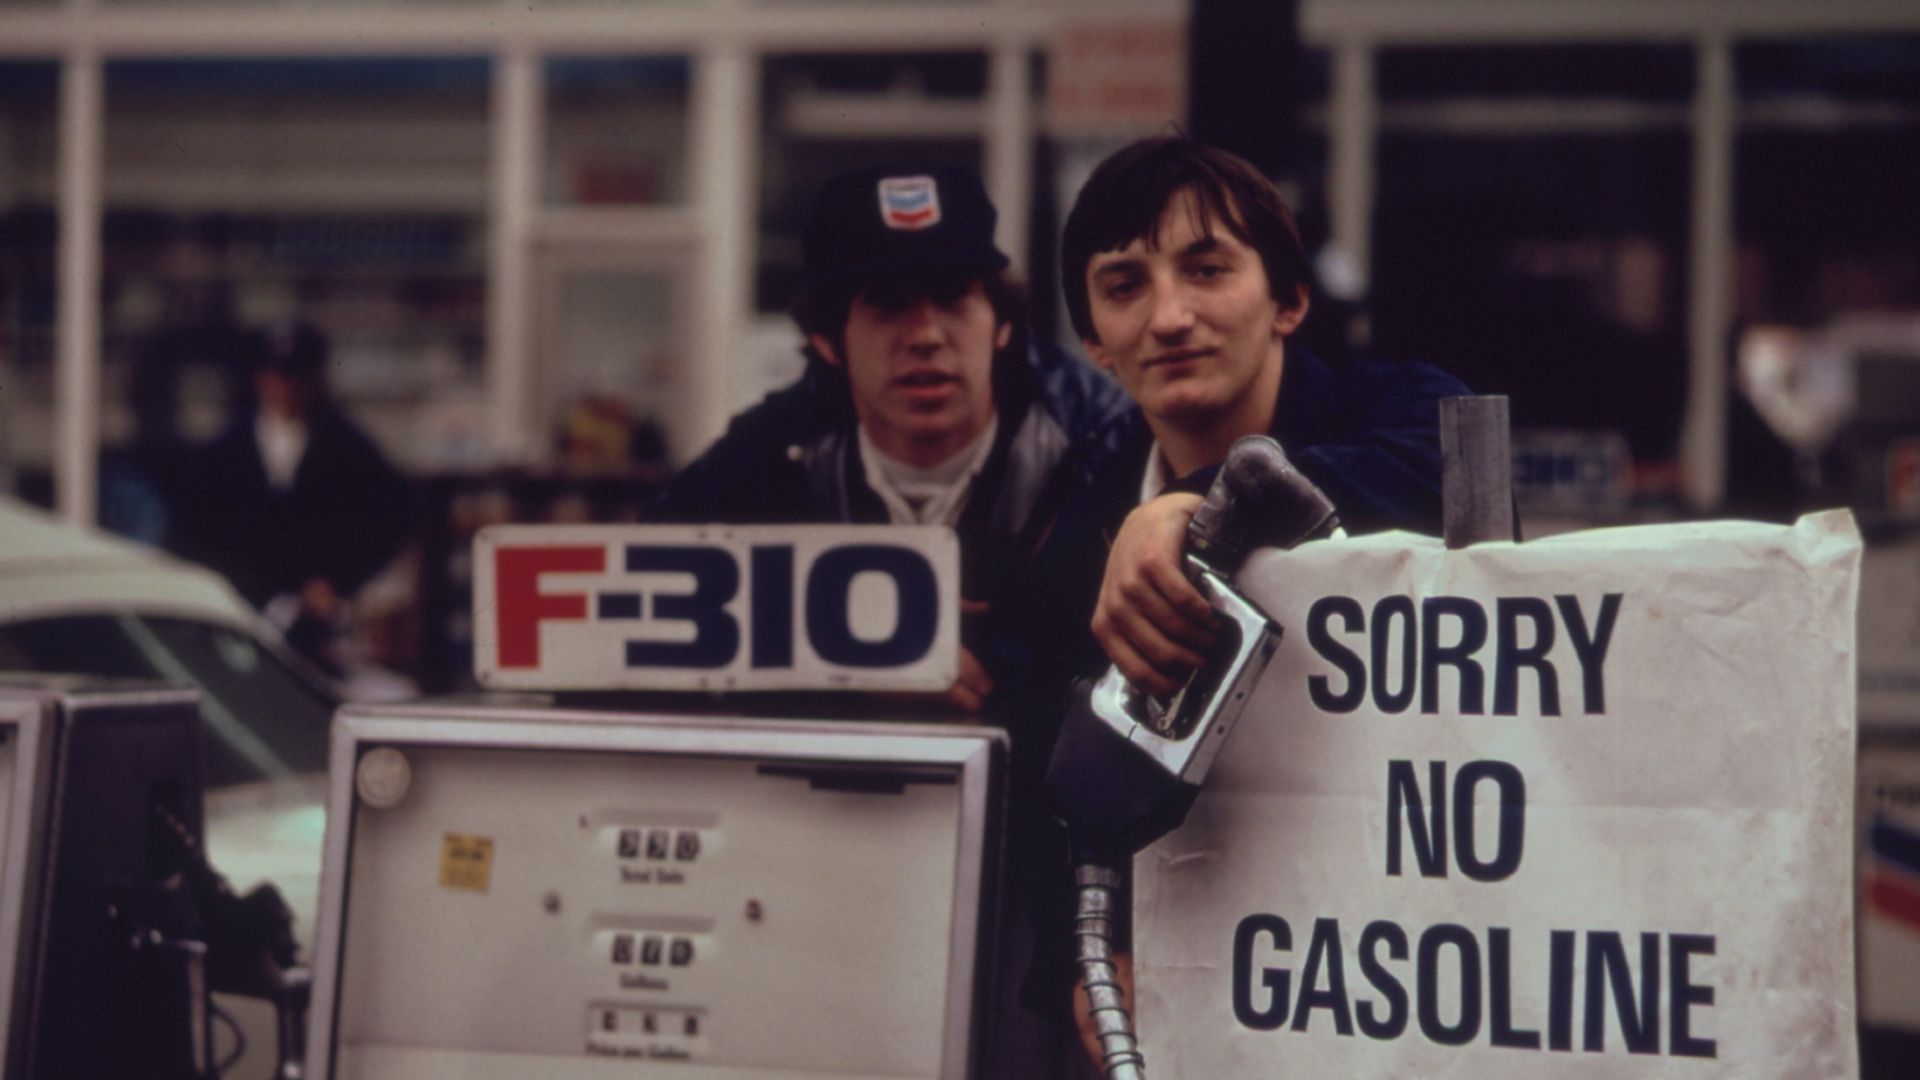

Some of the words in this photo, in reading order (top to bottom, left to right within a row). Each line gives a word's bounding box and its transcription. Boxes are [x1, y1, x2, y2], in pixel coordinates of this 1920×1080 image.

[495, 543, 940, 670] F-310
[1306, 593, 1623, 717] SORRY
[1386, 759, 1526, 883] NO
[1232, 912, 1717, 1059] GASOLINE
